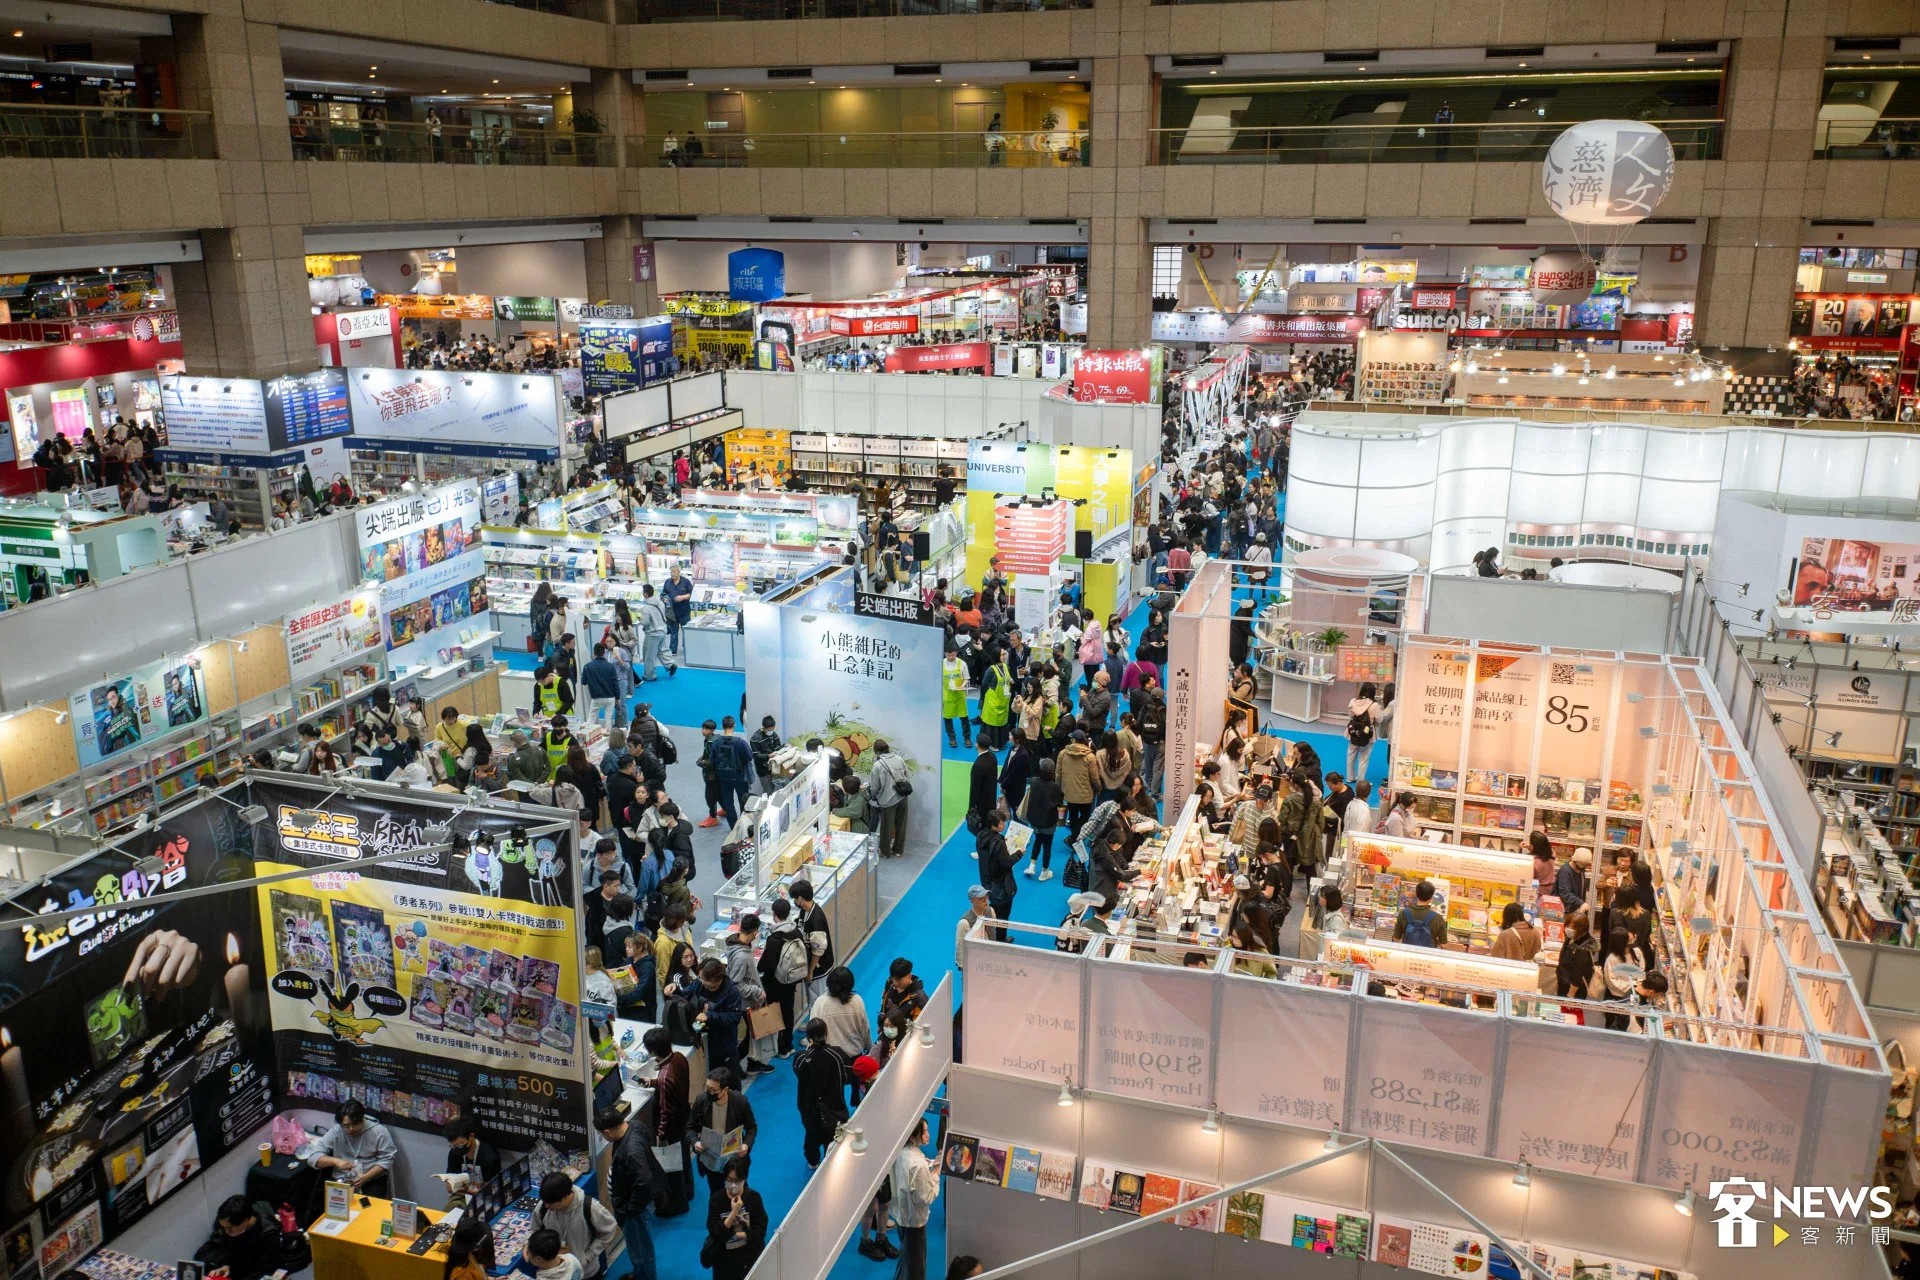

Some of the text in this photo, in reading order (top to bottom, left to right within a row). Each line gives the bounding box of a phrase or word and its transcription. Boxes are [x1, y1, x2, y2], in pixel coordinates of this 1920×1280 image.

[1569, 140, 1607, 208] 慈濟
[1613, 136, 1661, 212] 人文
[1538, 278, 1584, 290] 三采文化
[1539, 270, 1584, 280] suncolor
[1417, 292, 1452, 300] suncolor
[1417, 299, 1450, 307] 三采文化
[1824, 301, 1845, 316] 20
[352, 313, 389, 330] 蓋亞文化
[874, 320, 908, 332] 台灣角川
[1255, 320, 1346, 332] 讀書共和國出版集團
[1396, 311, 1490, 330] suncolor
[1822, 320, 1842, 335] 50
[1078, 356, 1144, 374] 時報出版
[968, 462, 1026, 475] UNIVERSITY
[1092, 453, 1112, 524] 大學之道
[366, 500, 424, 538] 尖端出版
[860, 596, 918, 620] 尖端出版
[1810, 592, 1839, 620] 客
[820, 630, 901, 660] 小熊維尼的
[827, 653, 894, 682] 正念筆記
[1427, 662, 1465, 677] 電子書
[152, 696, 163, 710] 送
[1174, 680, 1189, 730] 誠品書店
[1424, 684, 1528, 708] 展期間 誠品線上
[1838, 692, 1870, 700] UNIVERSITY
[1424, 702, 1514, 722] 電子書 館再享
[1544, 695, 1589, 734] 85
[1172, 732, 1186, 816] eslite bookstore
[294, 840, 349, 856] 集換式卡牌遊戲
[393, 894, 566, 930] 《勇者系列》 參戰!!雙人卡牌對戰遊戲!!
[528, 1050, 576, 1068] 等你來收集!!
[478, 1074, 568, 1100] 展場滿500元
